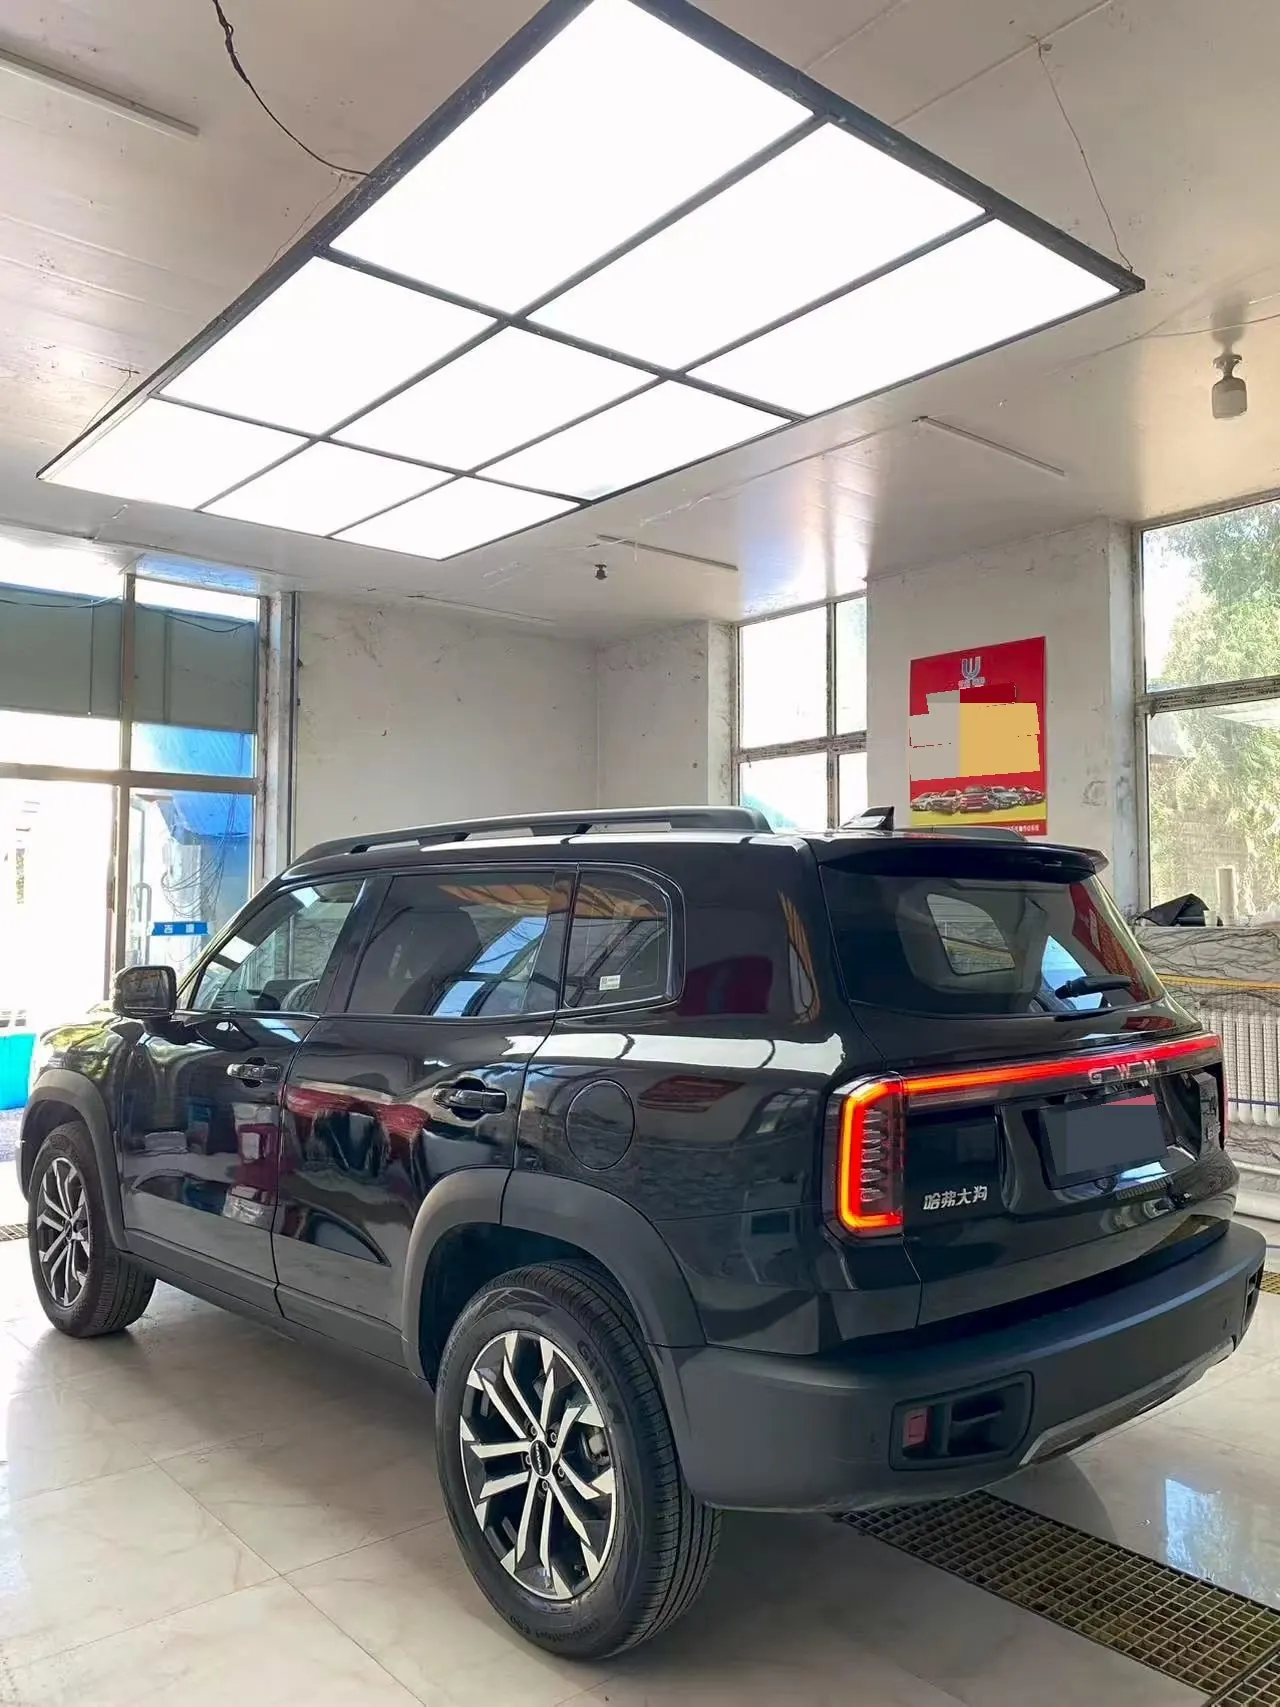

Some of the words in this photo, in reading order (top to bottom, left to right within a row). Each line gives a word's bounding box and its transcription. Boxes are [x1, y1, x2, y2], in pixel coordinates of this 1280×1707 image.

[1088, 1059, 1157, 1084] GWM
[922, 1185, 988, 1210] 哈弗大狗
